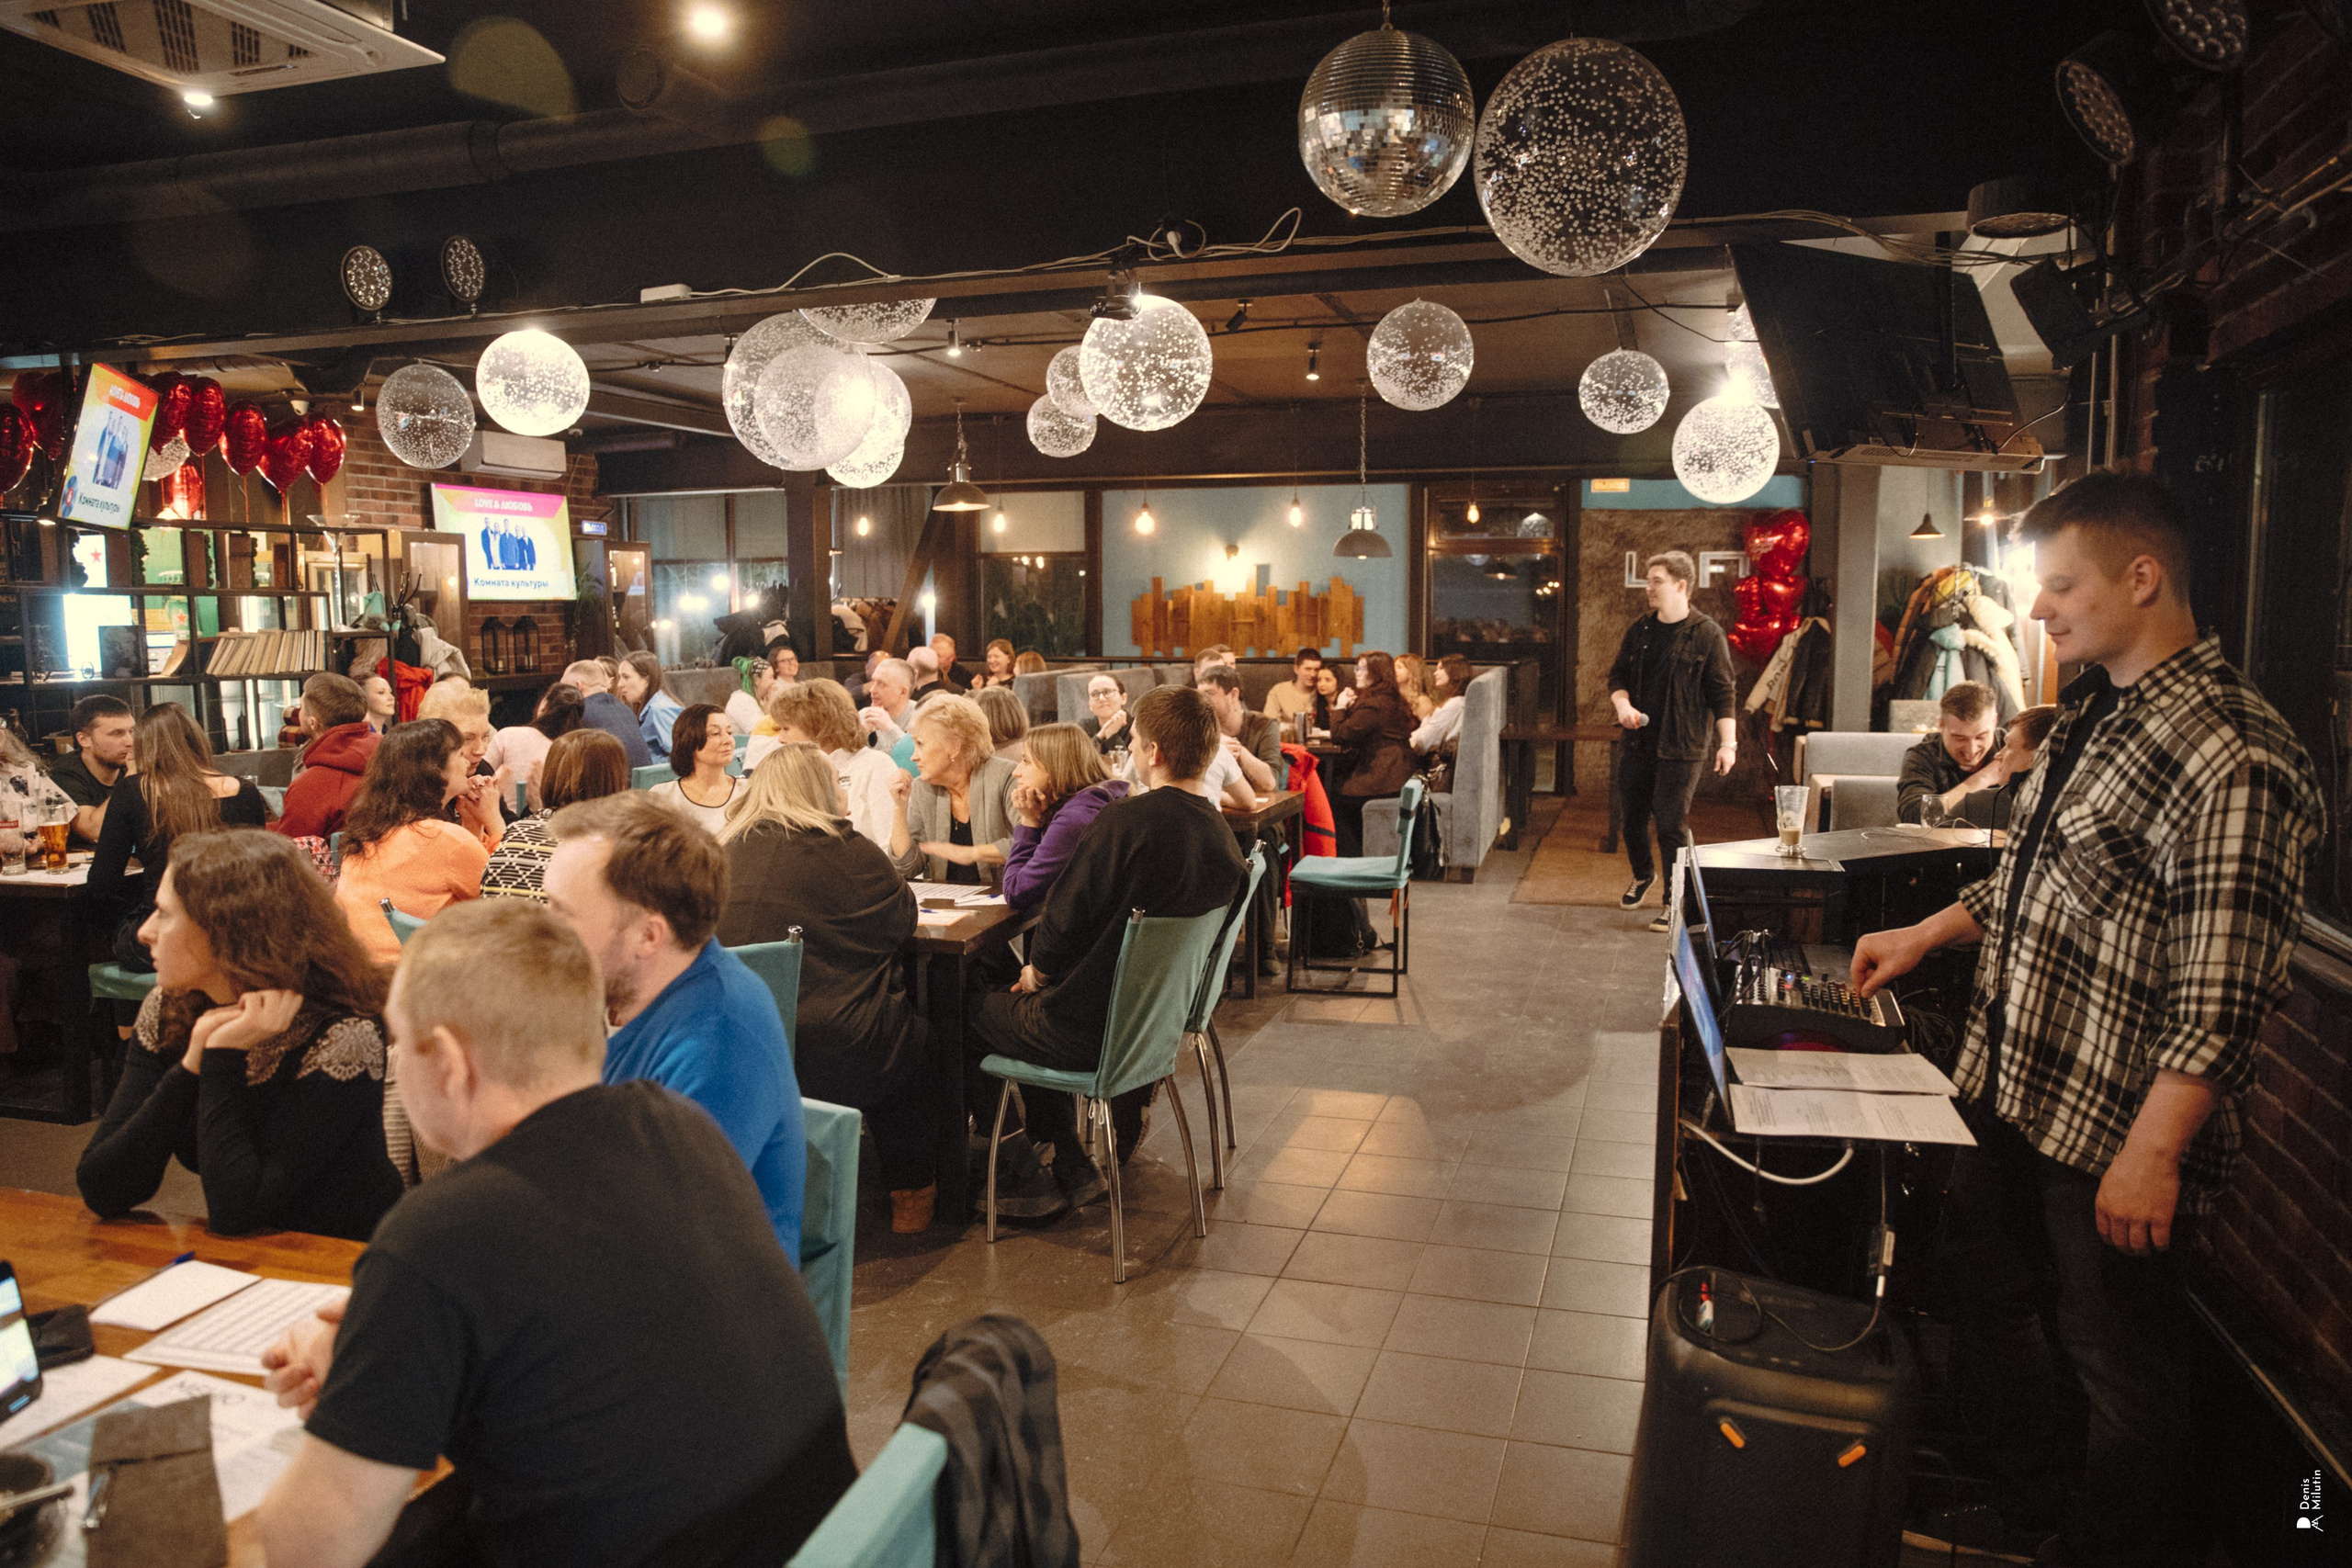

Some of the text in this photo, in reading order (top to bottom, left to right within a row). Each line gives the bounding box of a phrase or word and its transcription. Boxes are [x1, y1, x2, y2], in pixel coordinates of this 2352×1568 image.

[78, 492, 100, 508] Комната
[475, 498, 493, 509] LOVE
[474, 578, 548, 590] Комната культуры
